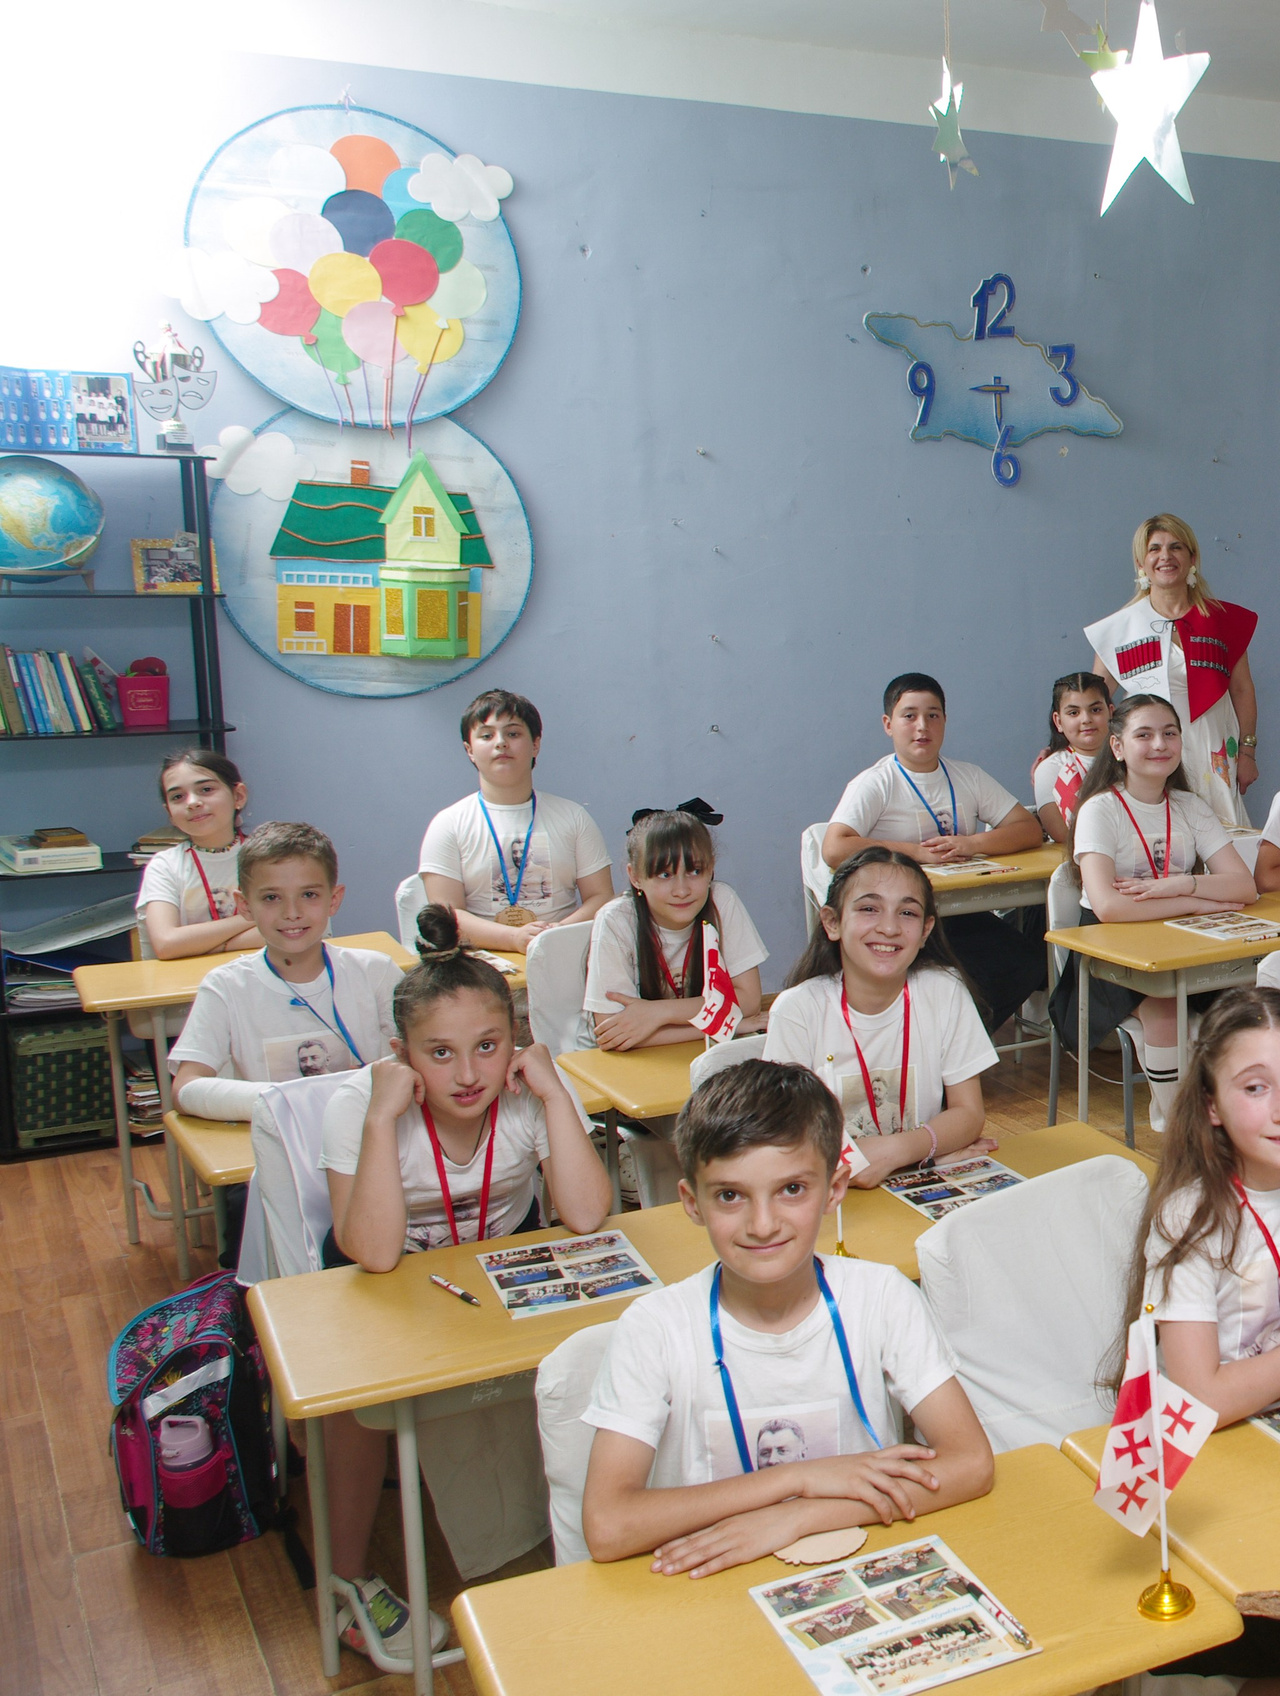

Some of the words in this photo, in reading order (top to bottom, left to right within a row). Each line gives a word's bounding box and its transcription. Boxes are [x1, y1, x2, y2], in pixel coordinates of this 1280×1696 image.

[971, 273, 1016, 341] 12
[907, 361, 936, 426] 9
[1048, 344, 1079, 407] 3
[991, 425, 1021, 487] 6
